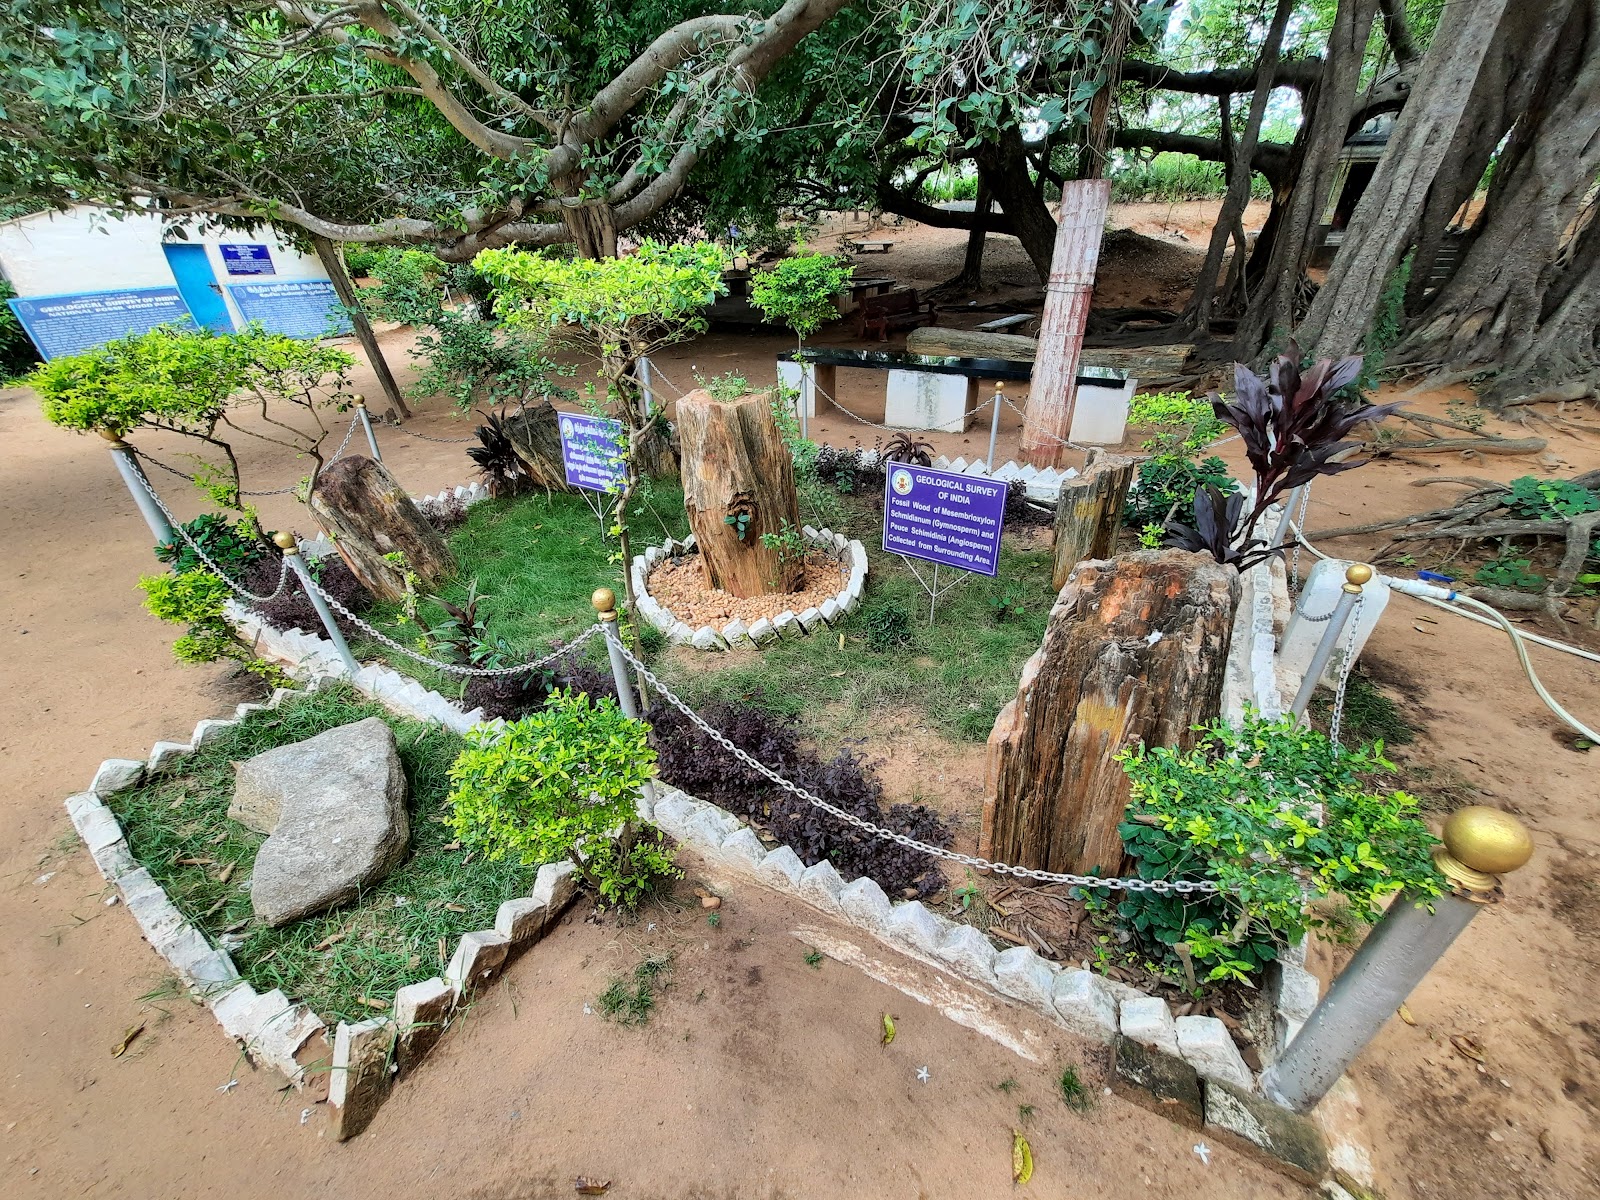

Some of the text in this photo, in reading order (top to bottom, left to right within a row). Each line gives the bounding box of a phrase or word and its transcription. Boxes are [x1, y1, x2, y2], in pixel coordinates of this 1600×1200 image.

[40, 302, 104, 313] GEOLOGICAL
[105, 298, 142, 306] SURVEY
[48, 309, 95, 317] NATIONAL
[916, 475, 998, 497] GEOLOGICAL SURVEY
[938, 491, 970, 505] OF INDIA
[891, 497, 996, 526] Fossil Wood of Mesembrioxylon
[890, 510, 994, 539] Schmidianum (Gymnosperm) and
[888, 534, 991, 565] Collected from Surrounding Area.
[890, 522, 992, 554] Peuce Schimidinia (Angiosperm)
